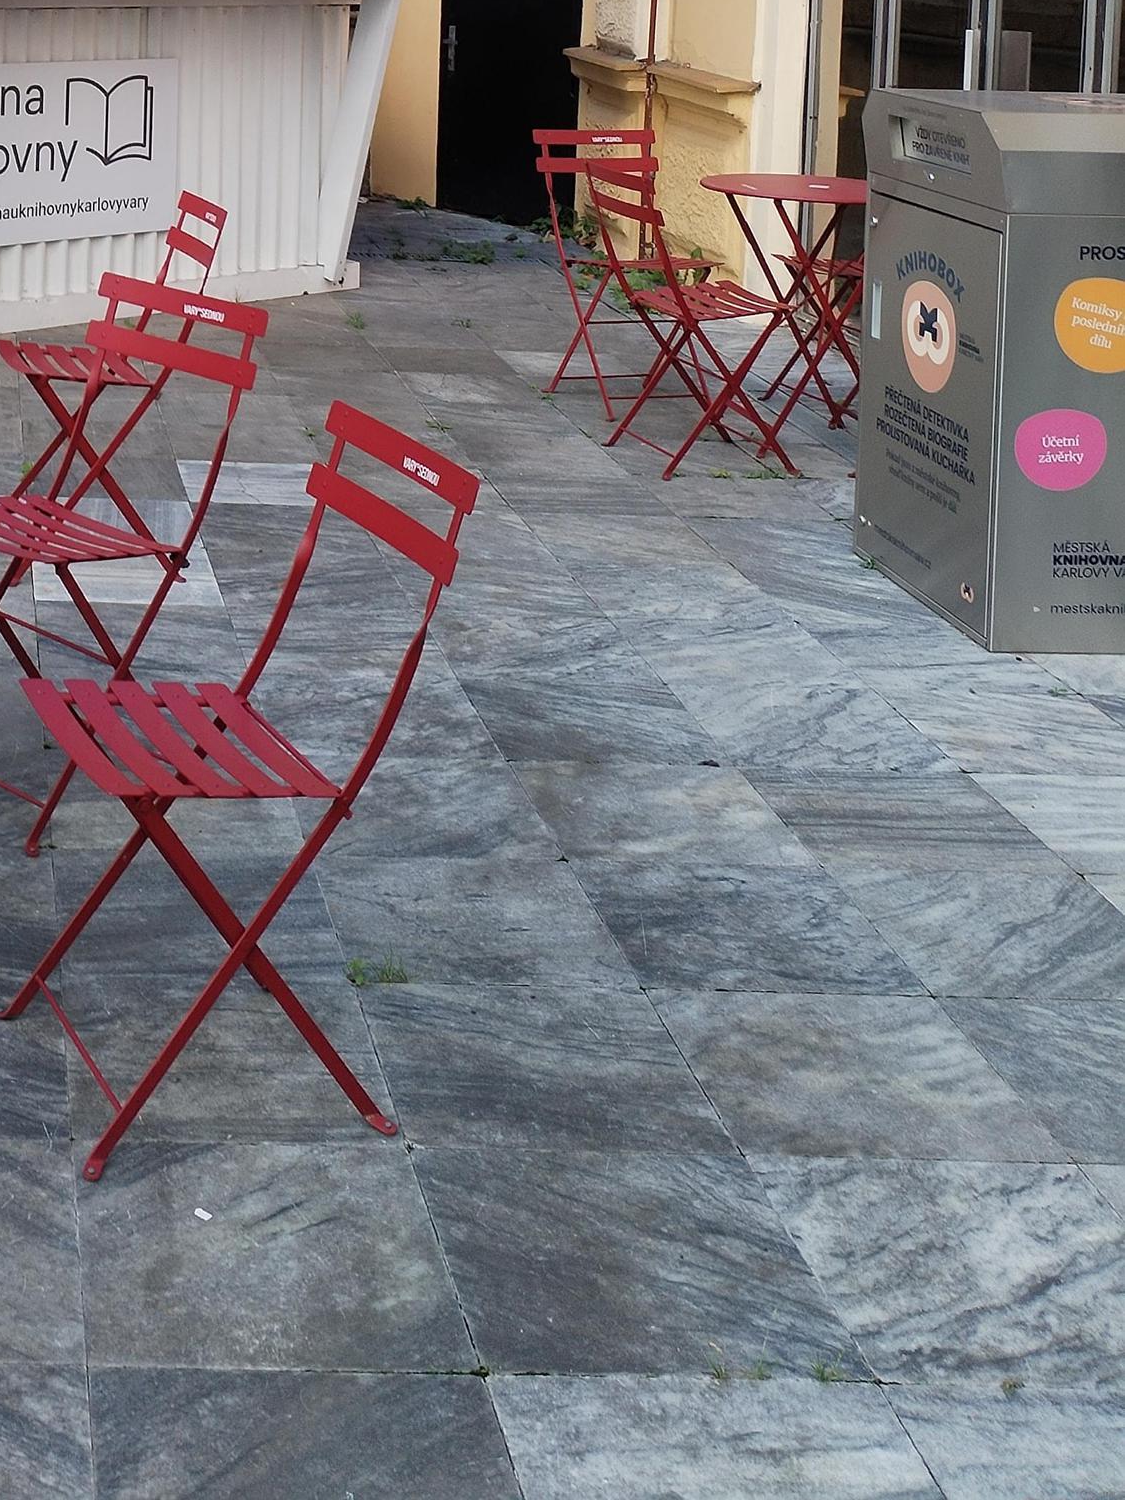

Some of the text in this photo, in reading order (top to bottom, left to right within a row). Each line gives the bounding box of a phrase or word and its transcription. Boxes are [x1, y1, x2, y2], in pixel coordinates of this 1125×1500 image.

[912, 140, 925, 154] PRO
[1080, 245, 1125, 261] PROS
[896, 250, 964, 302] KNIHOBOX
[1072, 297, 1122, 321] Komiksy
[1089, 334, 1112, 349] dílu
[884, 384, 969, 442] PŘEČTENÁ DETEKTIVKA
[884, 403, 969, 461] ROZEČTENÁ BIOGRAFIE
[1042, 434, 1080, 448] Účetní
[876, 417, 930, 459] PROLISTOVANÁ
[931, 448, 975, 486] KUCHAŘKA
[1038, 450, 1084, 465] závěrky
[1053, 540, 1110, 553] MĚSTSKÁ
[1052, 567, 1110, 579] KARLOVY
